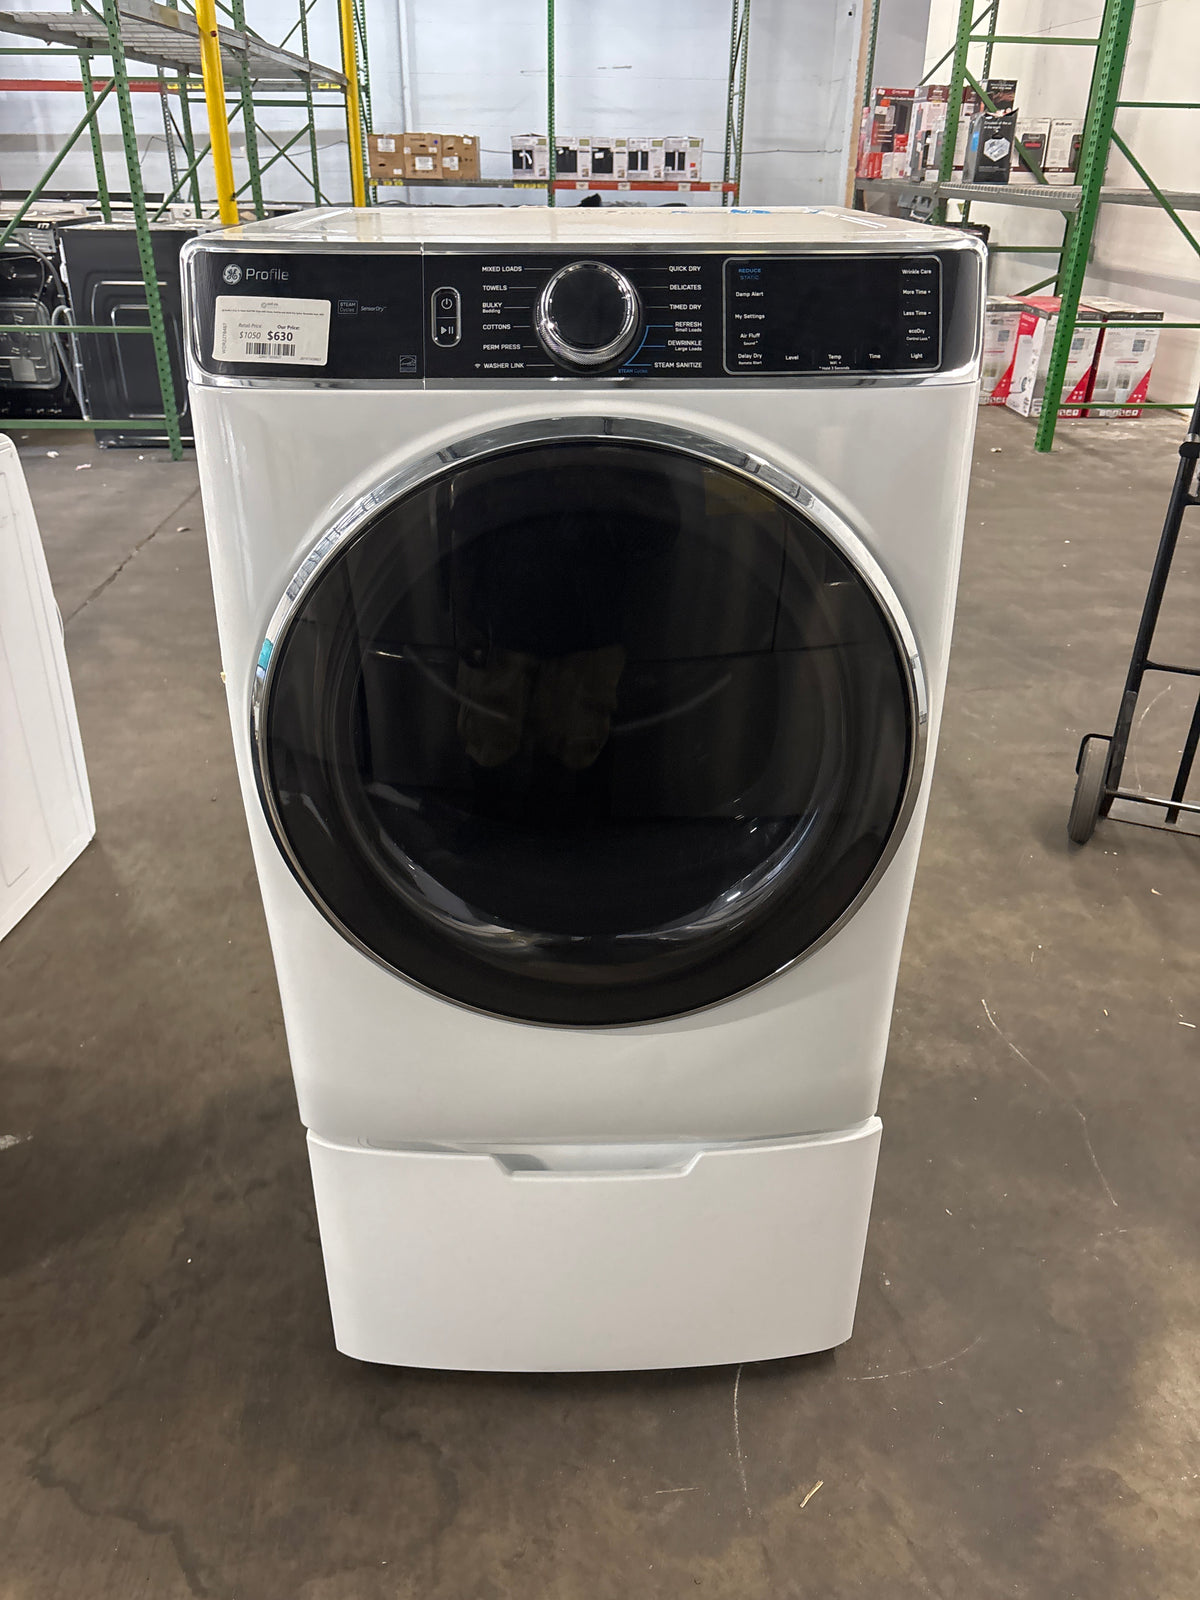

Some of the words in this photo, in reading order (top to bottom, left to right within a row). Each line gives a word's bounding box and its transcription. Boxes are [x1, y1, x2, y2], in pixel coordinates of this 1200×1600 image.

[245, 267, 289, 281] Profile
[240, 331, 261, 339] $1050
[267, 330, 293, 341] $630
